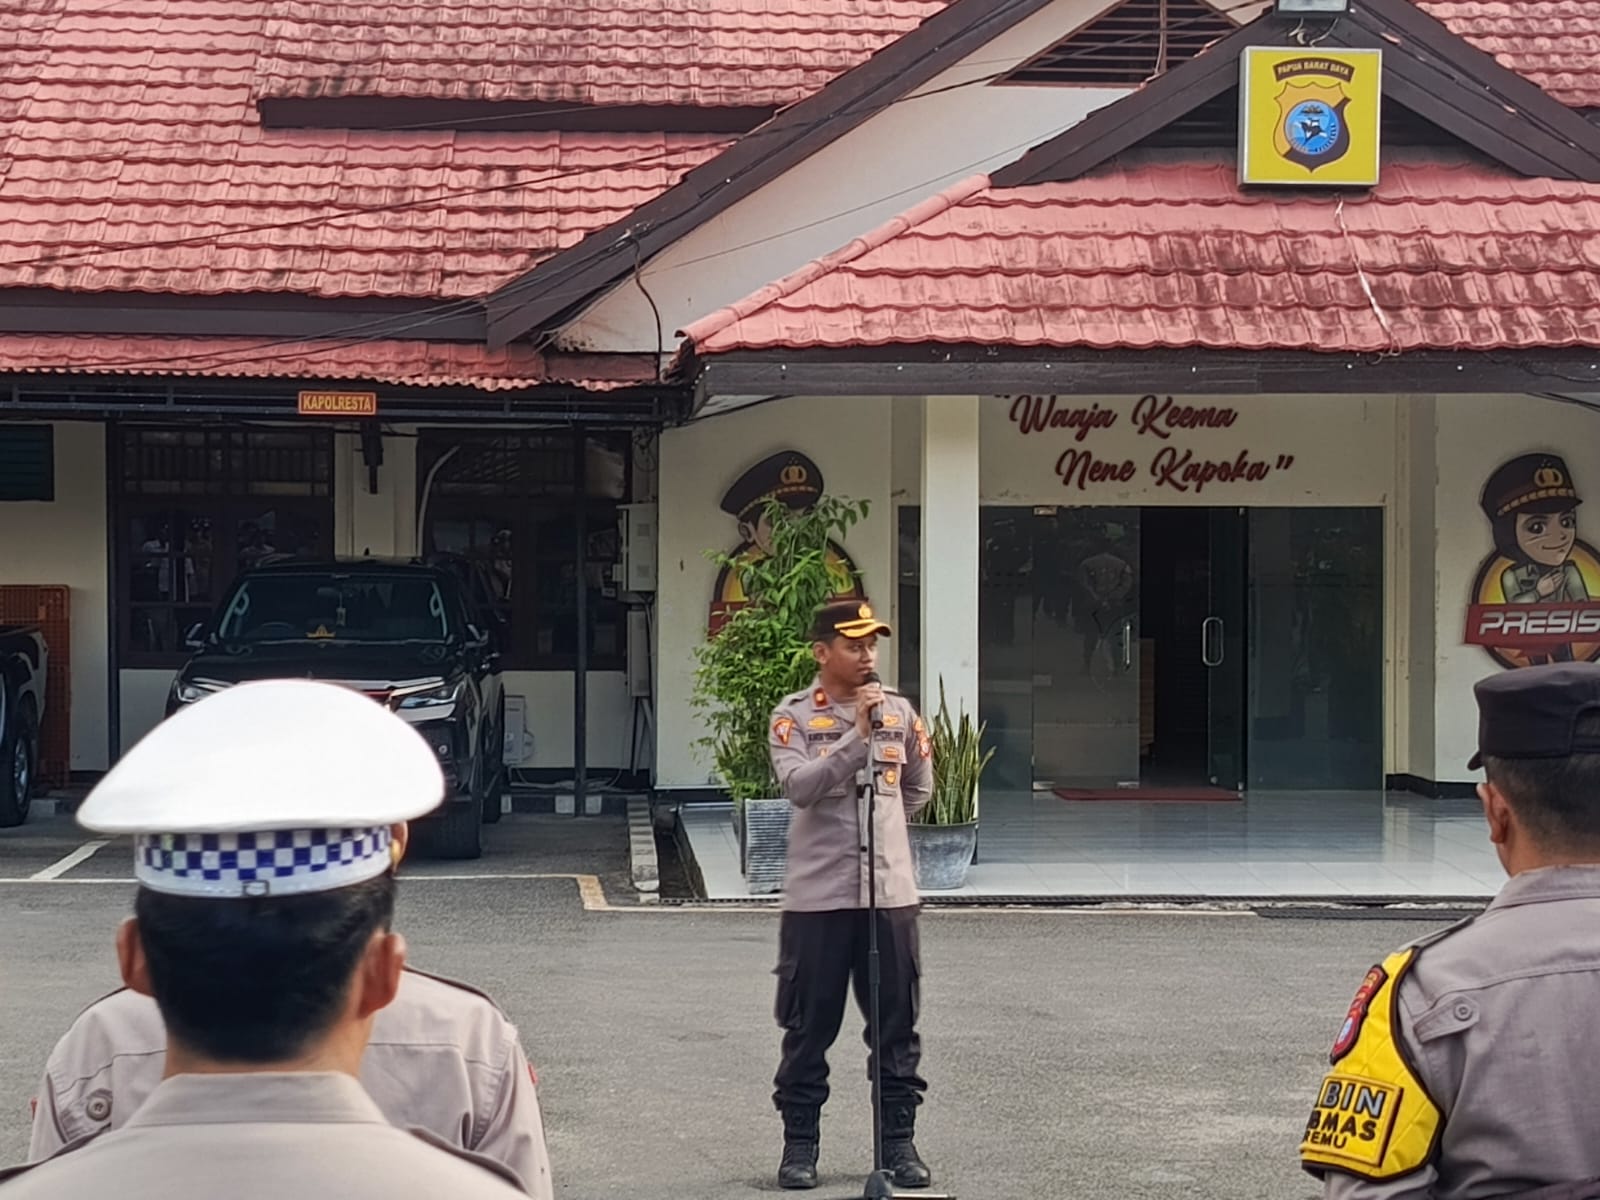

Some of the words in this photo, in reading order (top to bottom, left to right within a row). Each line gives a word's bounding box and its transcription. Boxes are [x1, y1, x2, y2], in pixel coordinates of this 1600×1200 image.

[1277, 62, 1302, 75] PAPUA
[1303, 61, 1329, 70] BARAT
[1329, 63, 1349, 75] DAYA
[303, 395, 372, 411] KAPOLRESTA
[994, 394, 1118, 442] Waaja
[1131, 394, 1239, 439] Keema
[1054, 448, 1137, 491] Nene
[1479, 609, 1600, 636] PRESIS
